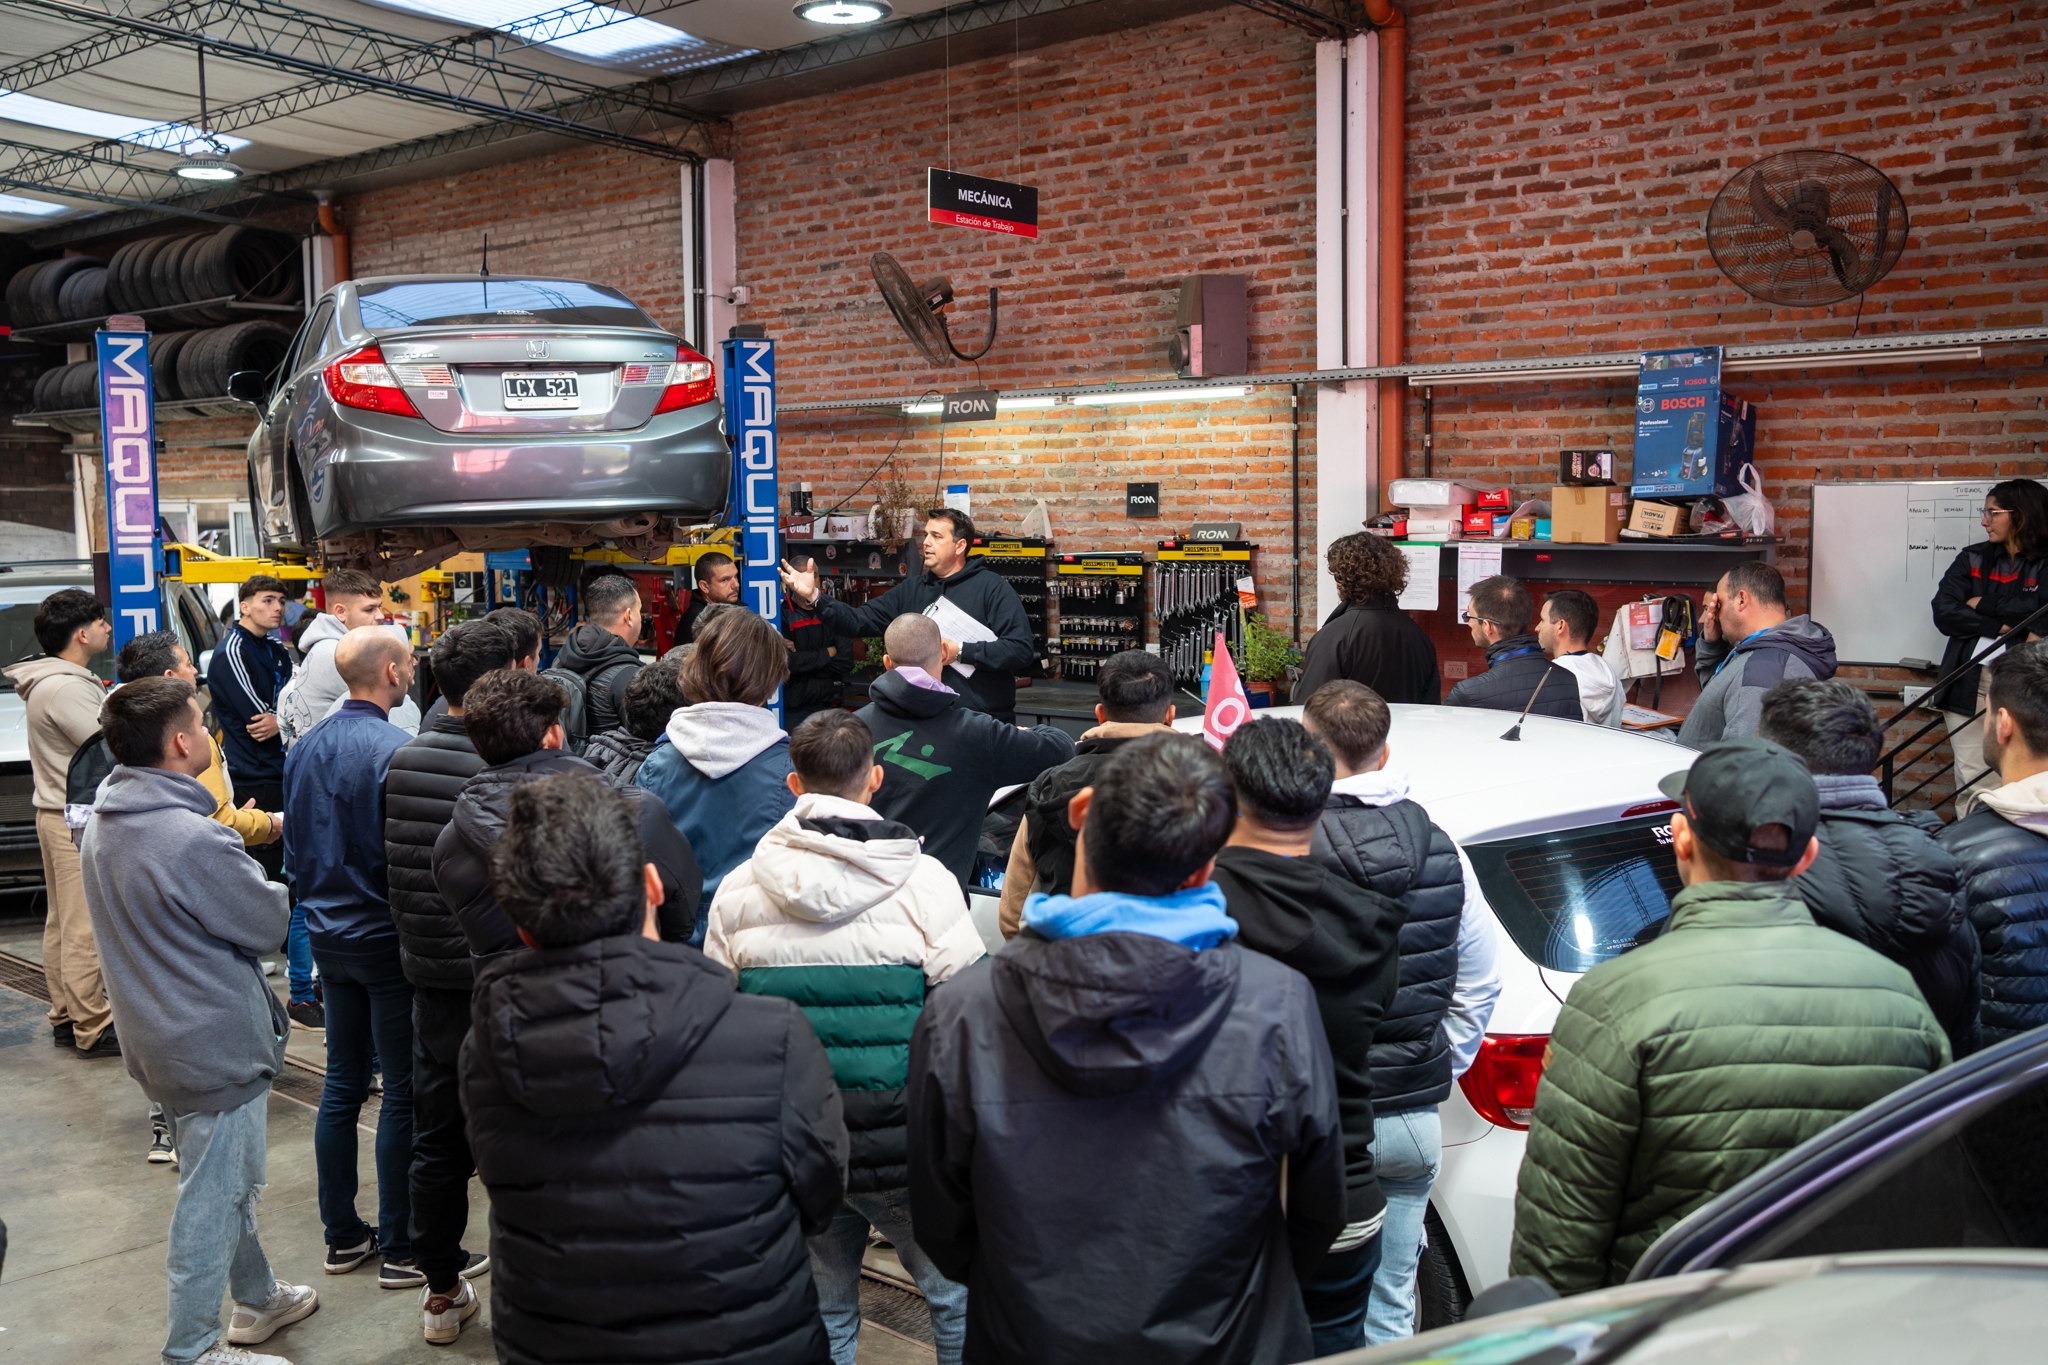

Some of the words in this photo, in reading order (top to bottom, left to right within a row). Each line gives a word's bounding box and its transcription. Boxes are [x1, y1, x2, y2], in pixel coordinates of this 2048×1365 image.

[958, 188, 1012, 209] MECÁNICA
[956, 214, 981, 226] Estación
[982, 219, 991, 228] de
[992, 220, 1014, 233] Trabajo
[506, 380, 537, 396] LCX
[546, 379, 577, 396] 521
[1684, 378, 1708, 386] BOSCH
[948, 399, 990, 414] ROM
[1661, 396, 1706, 410] BOSCH
[741, 341, 776, 567] MAQUIN
[106, 337, 155, 593] MAQUIN
[1130, 495, 1156, 504] ROM
[1196, 530, 1230, 540] ROM
[1651, 825, 1674, 838] RO
